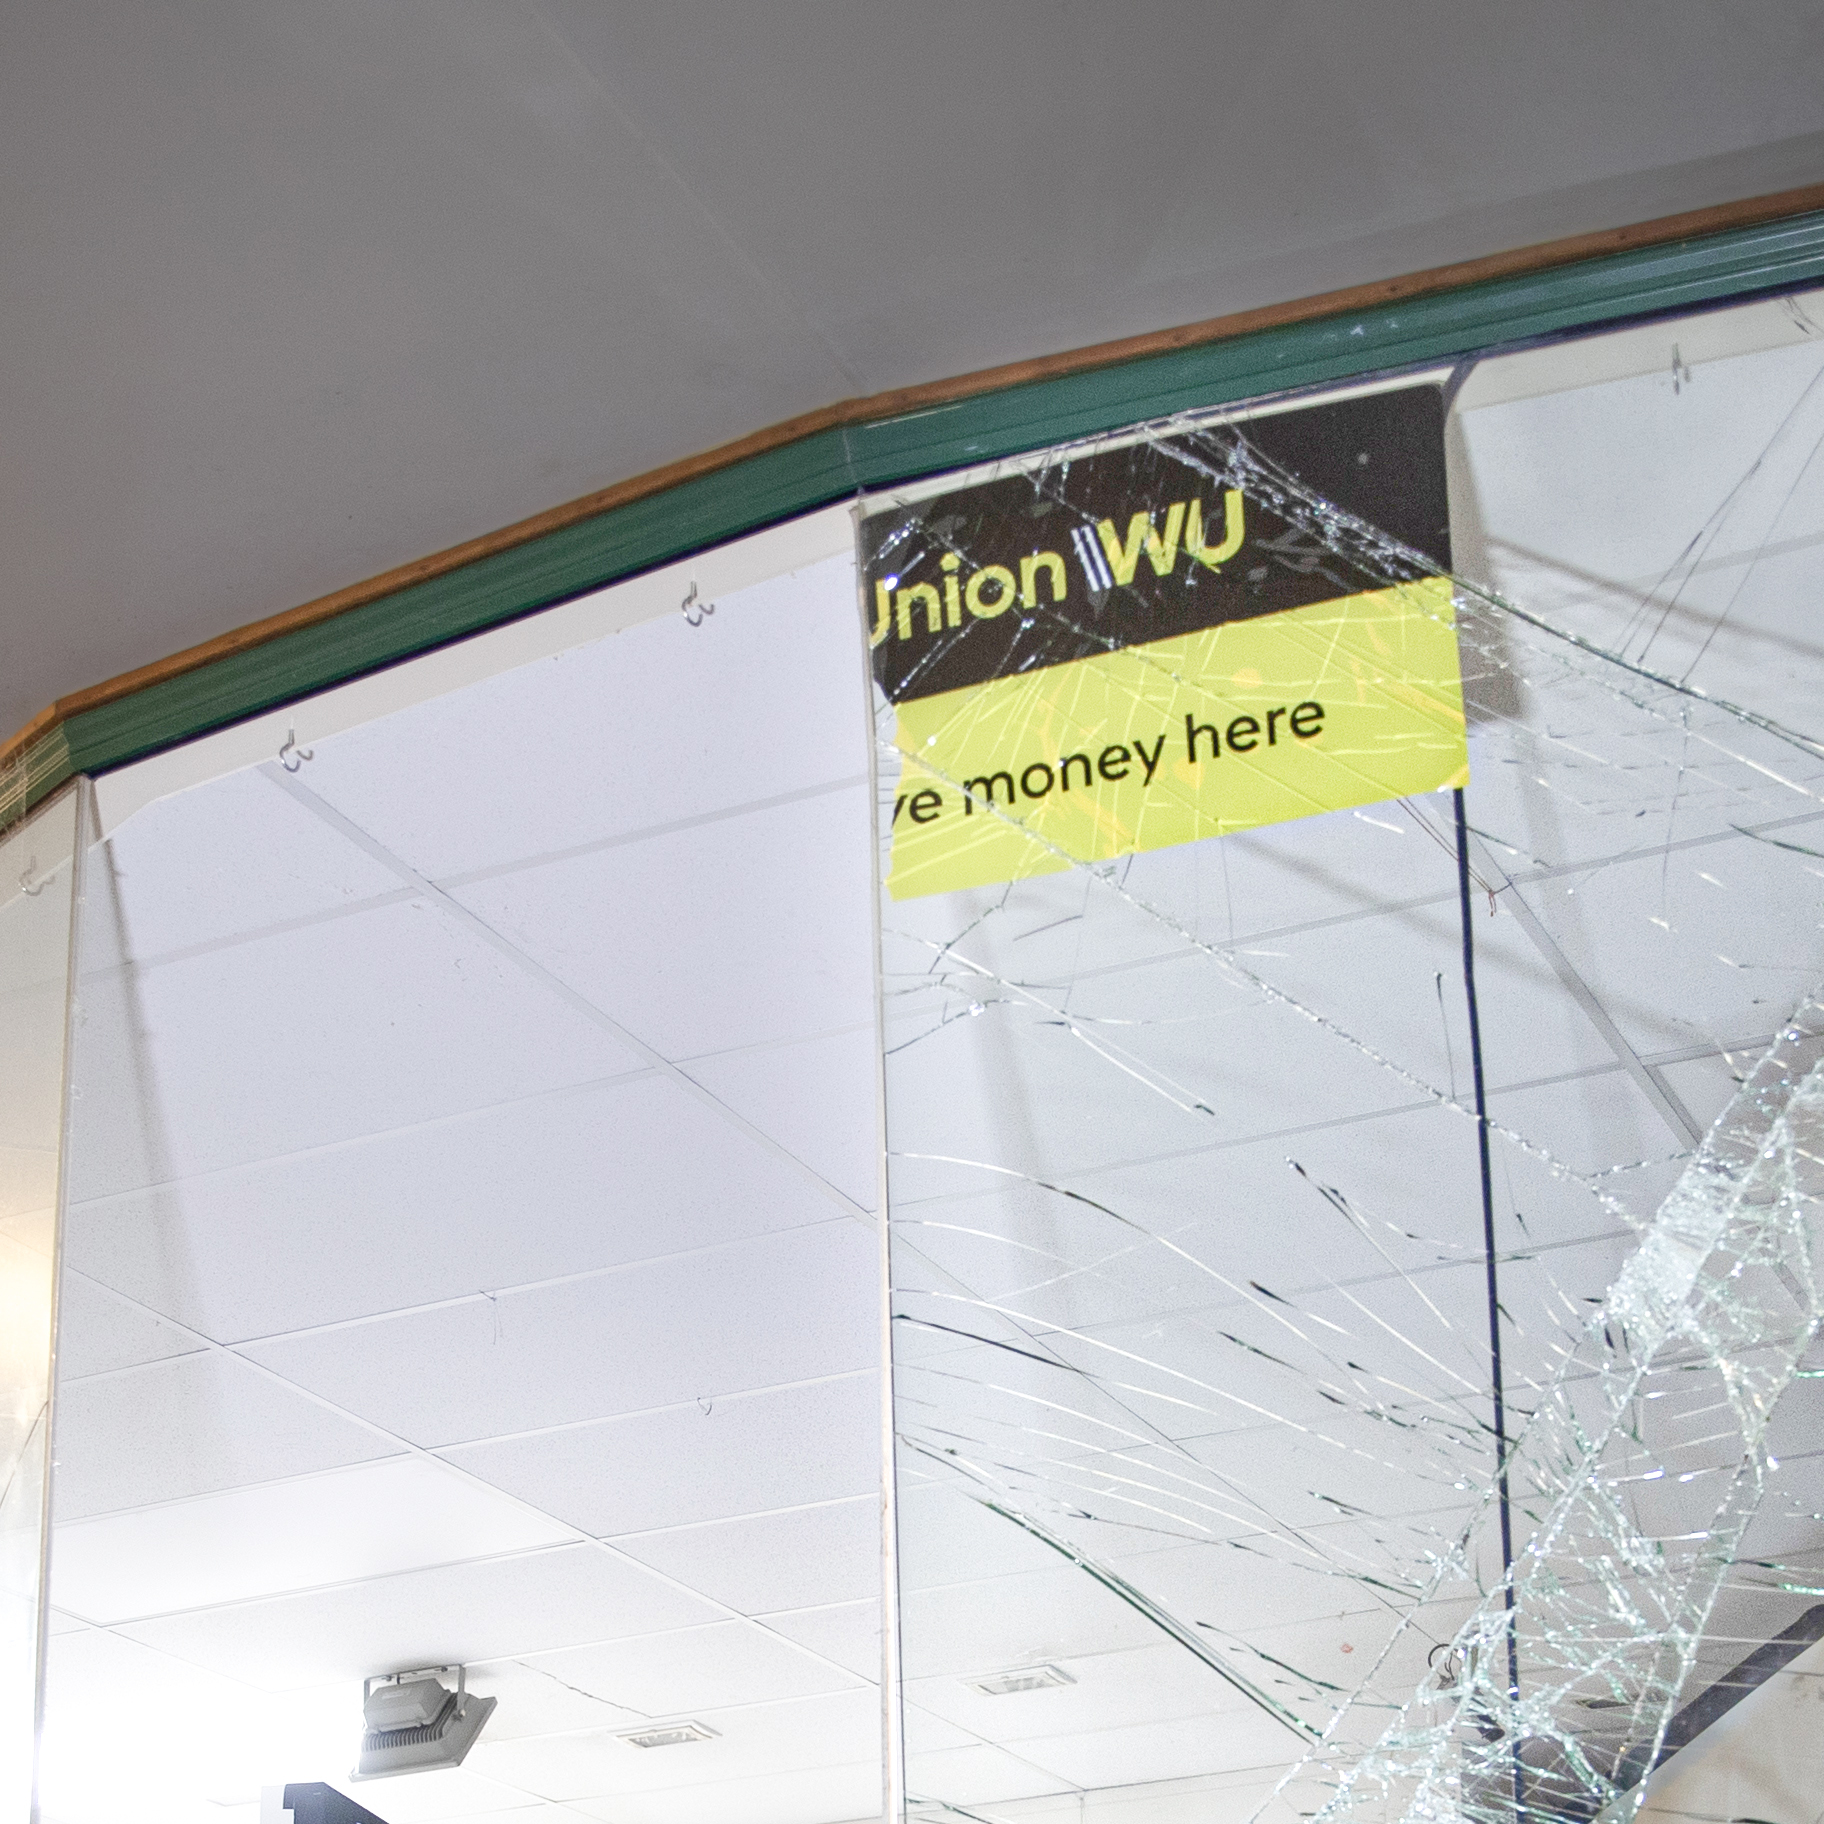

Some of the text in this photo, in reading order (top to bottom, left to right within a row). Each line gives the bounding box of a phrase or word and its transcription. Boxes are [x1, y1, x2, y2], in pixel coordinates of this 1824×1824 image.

[1097, 488, 1246, 589] WU
[962, 732, 1167, 813] money
[1183, 699, 1326, 765] here
